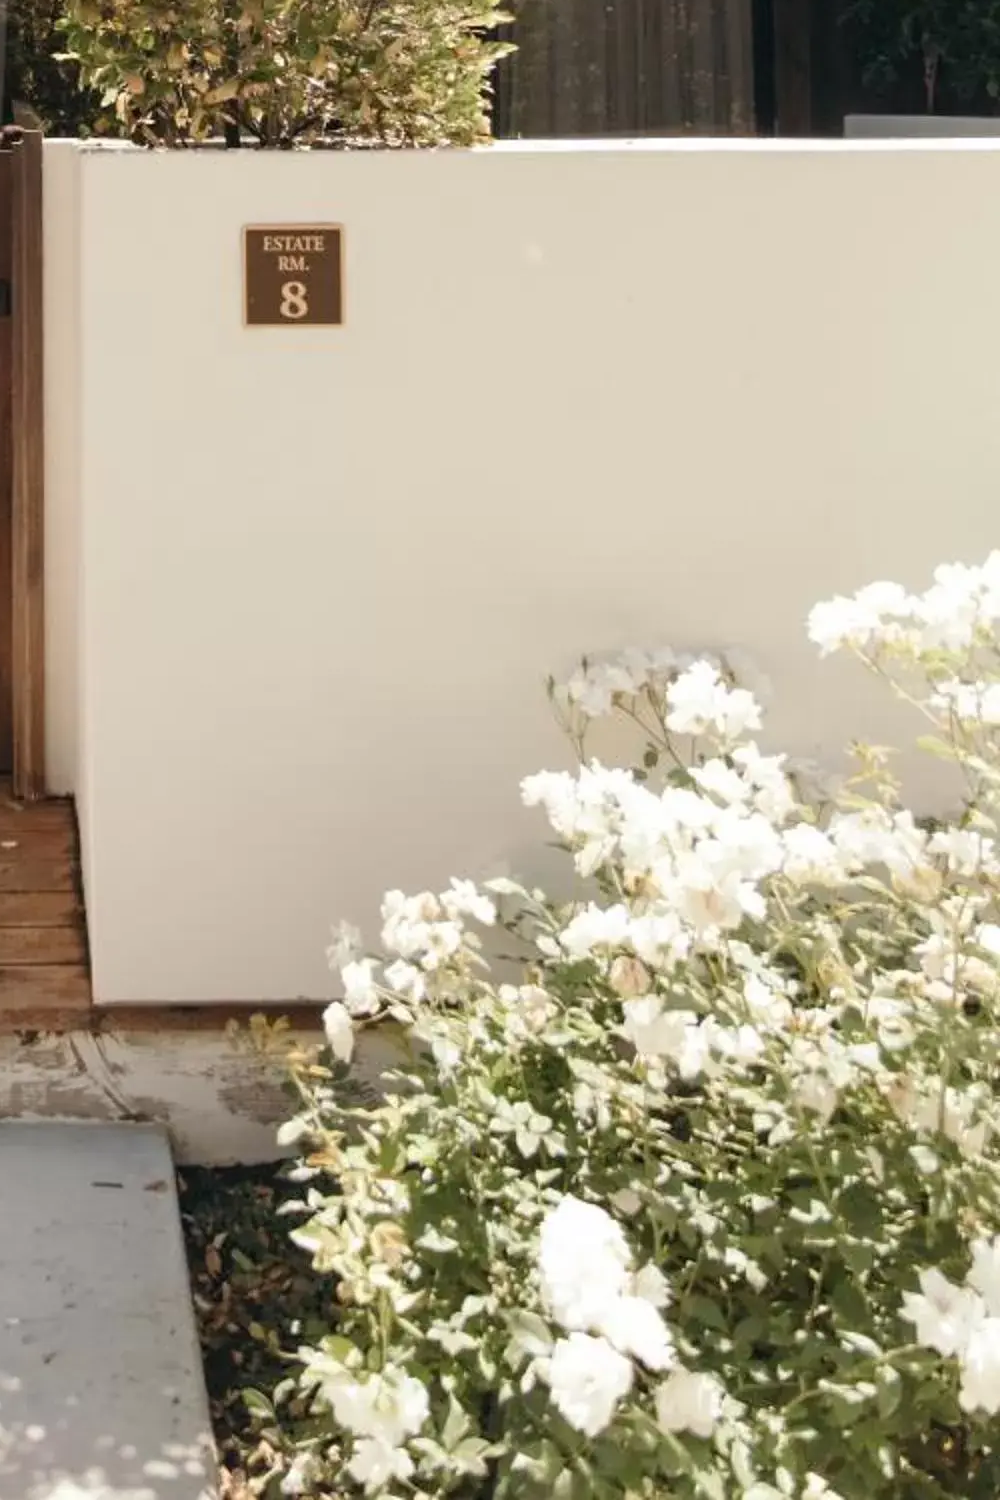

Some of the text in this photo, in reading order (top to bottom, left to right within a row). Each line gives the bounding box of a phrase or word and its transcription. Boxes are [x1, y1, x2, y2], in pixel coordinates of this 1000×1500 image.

[263, 236, 325, 251] ESTATE
[278, 256, 310, 271] RM.
[280, 281, 308, 319] 8
